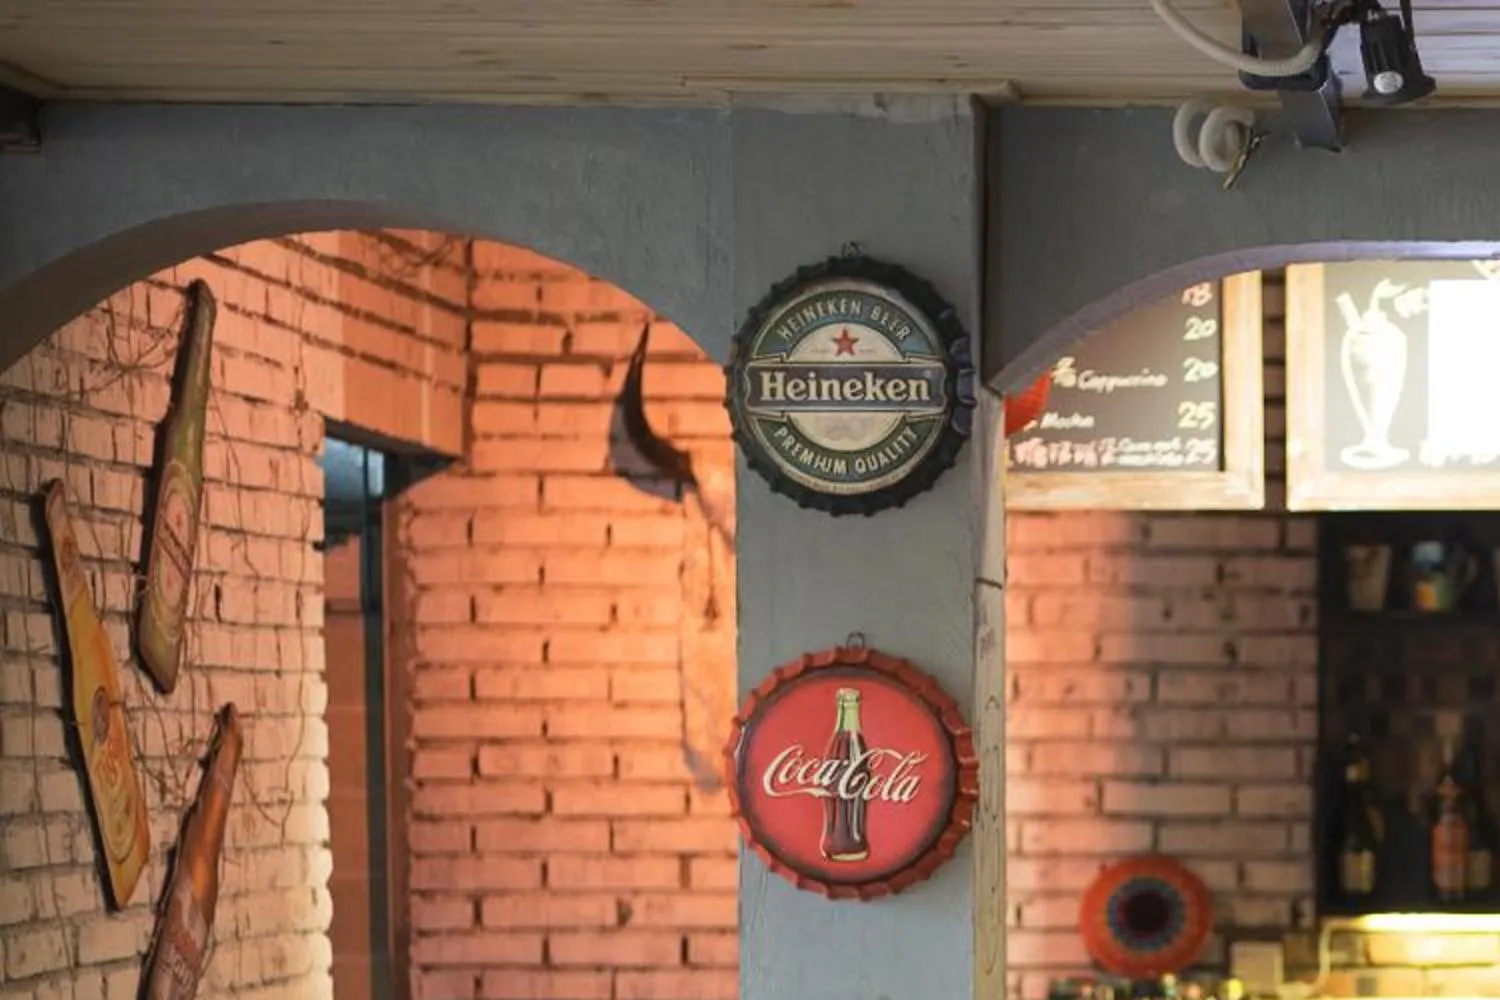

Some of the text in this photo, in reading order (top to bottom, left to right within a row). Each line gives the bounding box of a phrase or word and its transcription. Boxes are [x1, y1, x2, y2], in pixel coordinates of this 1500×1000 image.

[777, 300, 912, 341] HEINEKEN BEER
[1183, 316, 1217, 341] 20
[1183, 357, 1218, 382] 20
[760, 371, 930, 401] Heineken
[1178, 402, 1217, 430] 25
[773, 426, 918, 475] PREMIUM QUALITY
[1184, 438, 1217, 465] 25
